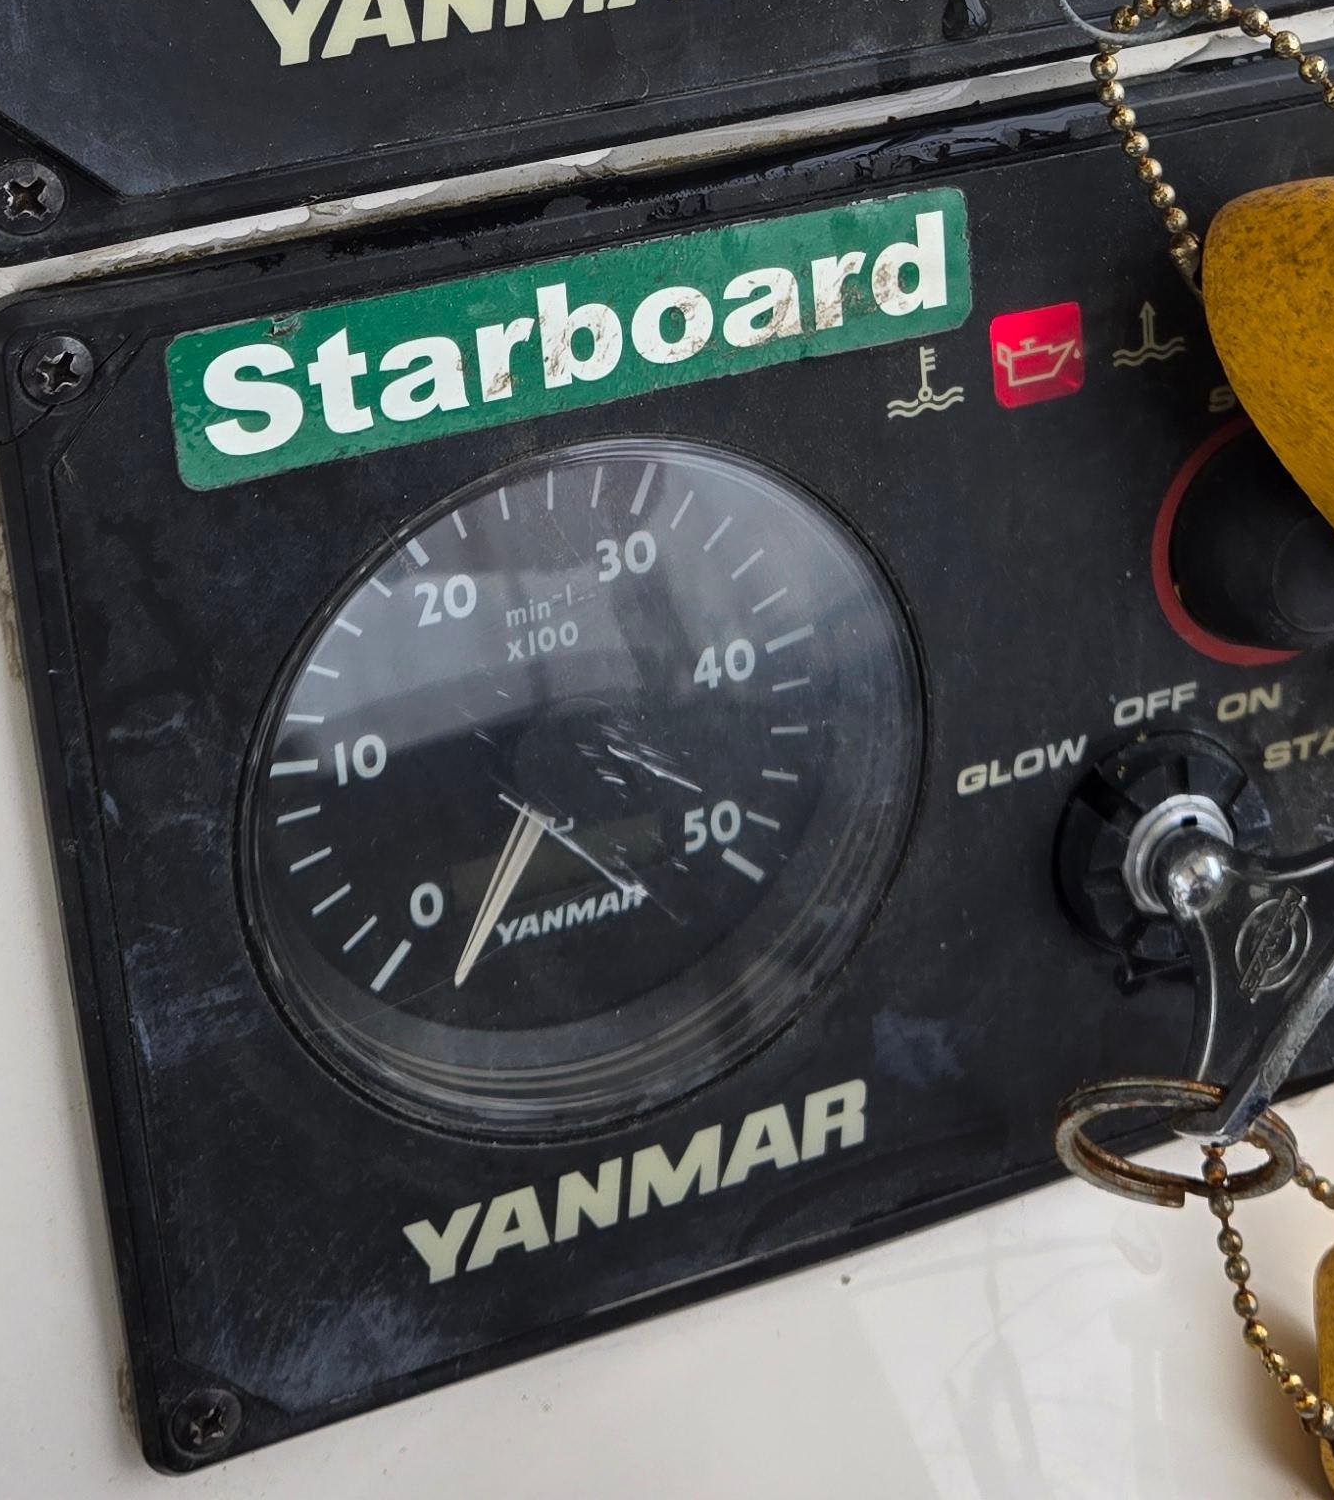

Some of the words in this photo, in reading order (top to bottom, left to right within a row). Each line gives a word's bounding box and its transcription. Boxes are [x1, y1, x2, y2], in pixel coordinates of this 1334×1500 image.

[204, 211, 947, 456] Starboard
[597, 530, 656, 583] 30
[415, 575, 477, 627] 20
[693, 638, 755, 688] 40
[1113, 682, 1199, 727] OFF
[1217, 683, 1283, 722] ON
[335, 735, 387, 785] 10
[957, 736, 1089, 795] GLOW
[684, 801, 741, 853] 50
[410, 882, 443, 927] 0
[496, 883, 647, 947] YANMAR
[403, 1079, 867, 1284] YANMAR
